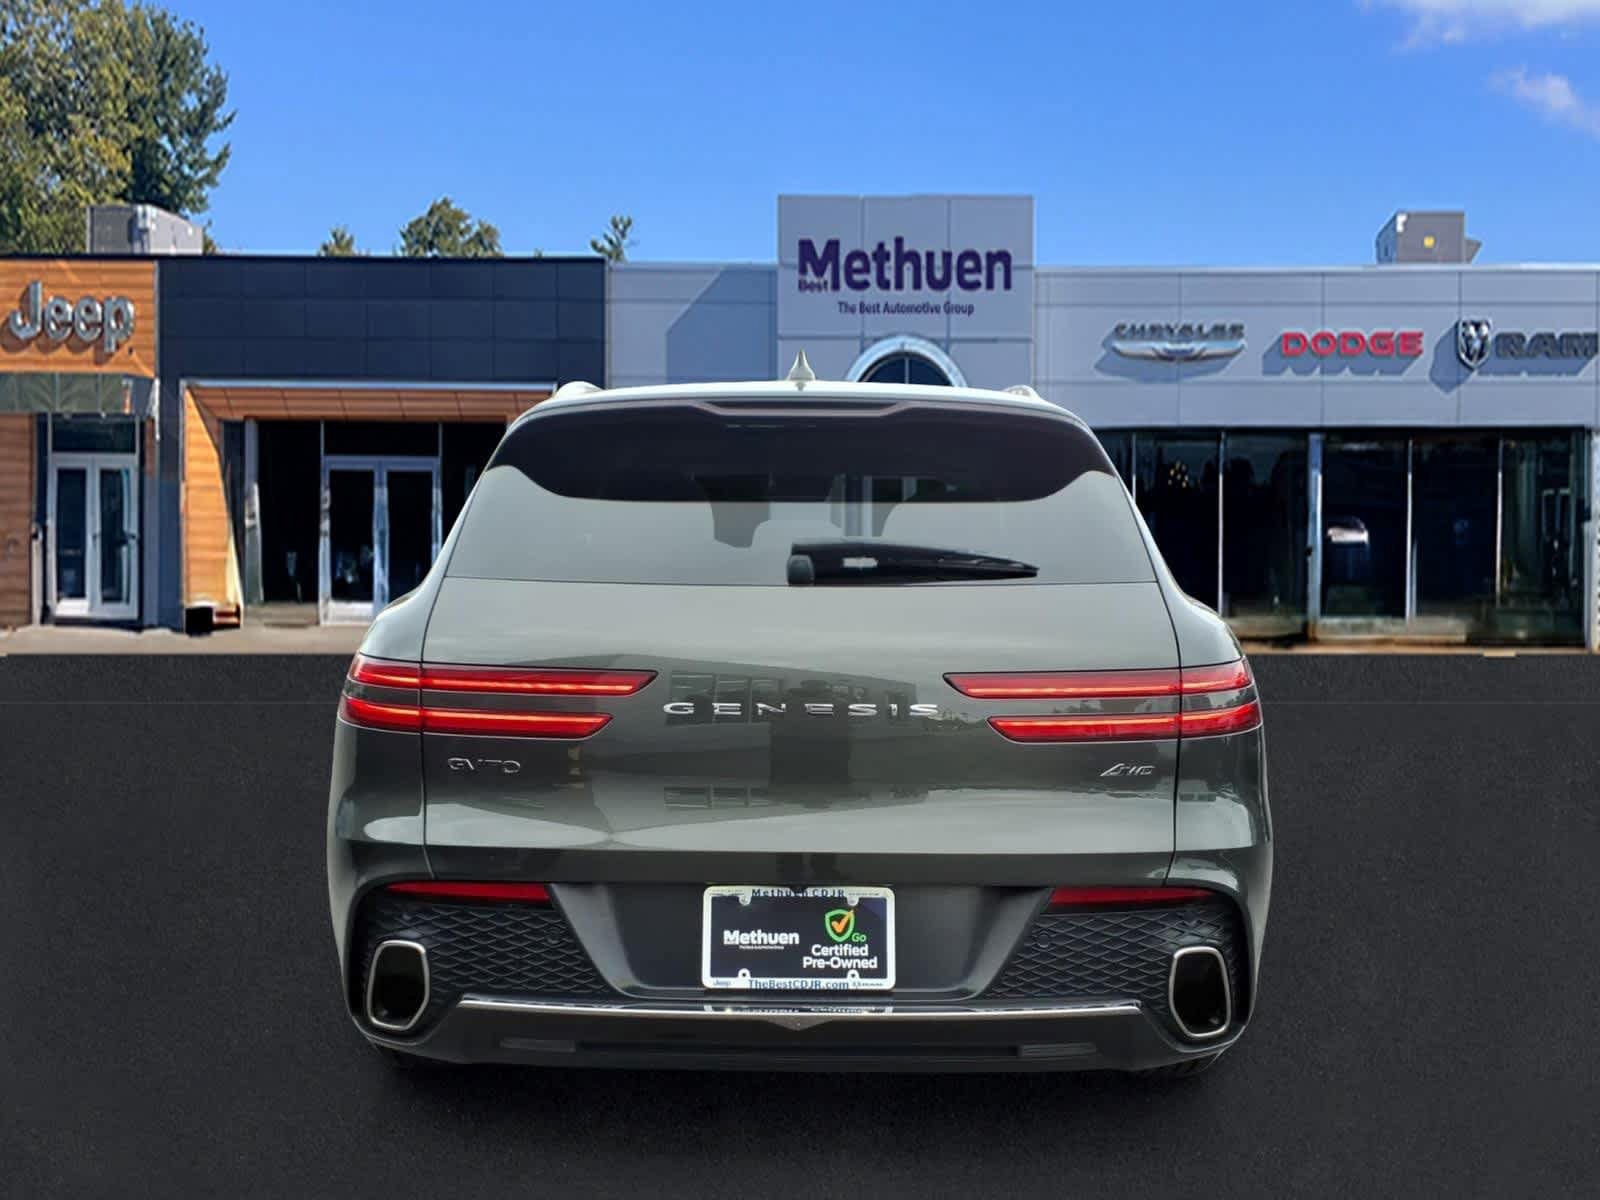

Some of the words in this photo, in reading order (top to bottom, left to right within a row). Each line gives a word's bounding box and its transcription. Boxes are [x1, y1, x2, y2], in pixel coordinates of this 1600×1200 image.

[798, 236, 1013, 292] Methuen
[9, 280, 135, 353] Jeep
[838, 301, 857, 314] The
[859, 301, 880, 314] Best
[883, 301, 941, 314] Automotive
[943, 300, 974, 317] Group
[1281, 331, 1424, 357] DODGE
[1494, 332, 1599, 358] RAM
[663, 702, 938, 716] GENESIS
[723, 929, 800, 945] Methuen
[852, 932, 867, 942] Go
[811, 944, 869, 956] Certified
[802, 956, 878, 969] Pre-Owned
[748, 979, 849, 989] TheBestCDJR.com
